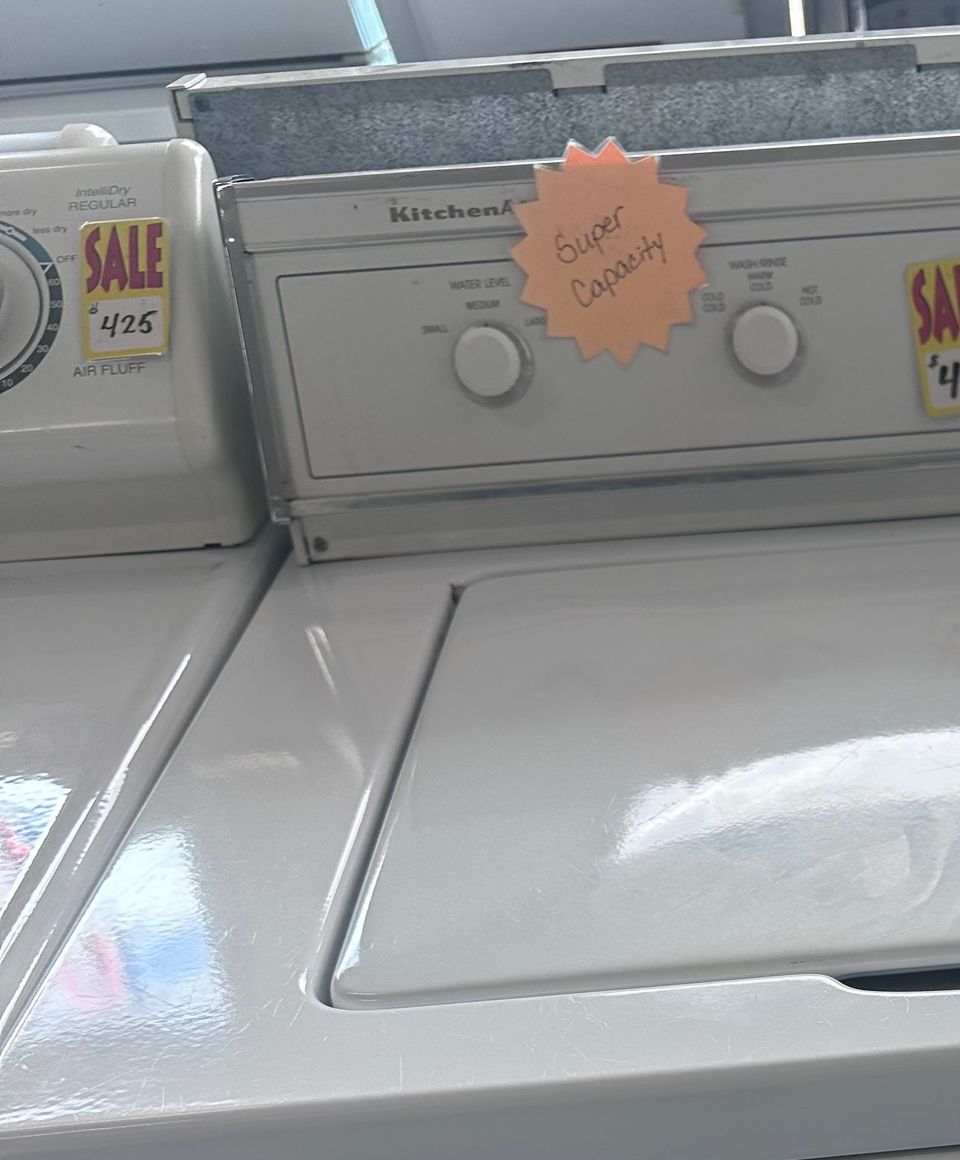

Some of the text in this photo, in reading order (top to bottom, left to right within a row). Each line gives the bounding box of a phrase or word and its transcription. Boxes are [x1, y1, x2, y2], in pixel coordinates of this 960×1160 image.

[67, 197, 137, 211] REGULAR
[389, 199, 527, 223] KitchenA
[555, 205, 624, 264] Super
[56, 254, 77, 264] OFF
[85, 222, 163, 294] SALE
[571, 232, 667, 308] Capacity
[449, 276, 511, 290] WATER LEVEL
[50, 300, 63, 309] 50
[21, 364, 33, 373] 20
[73, 361, 147, 377] AIR FLUFF
